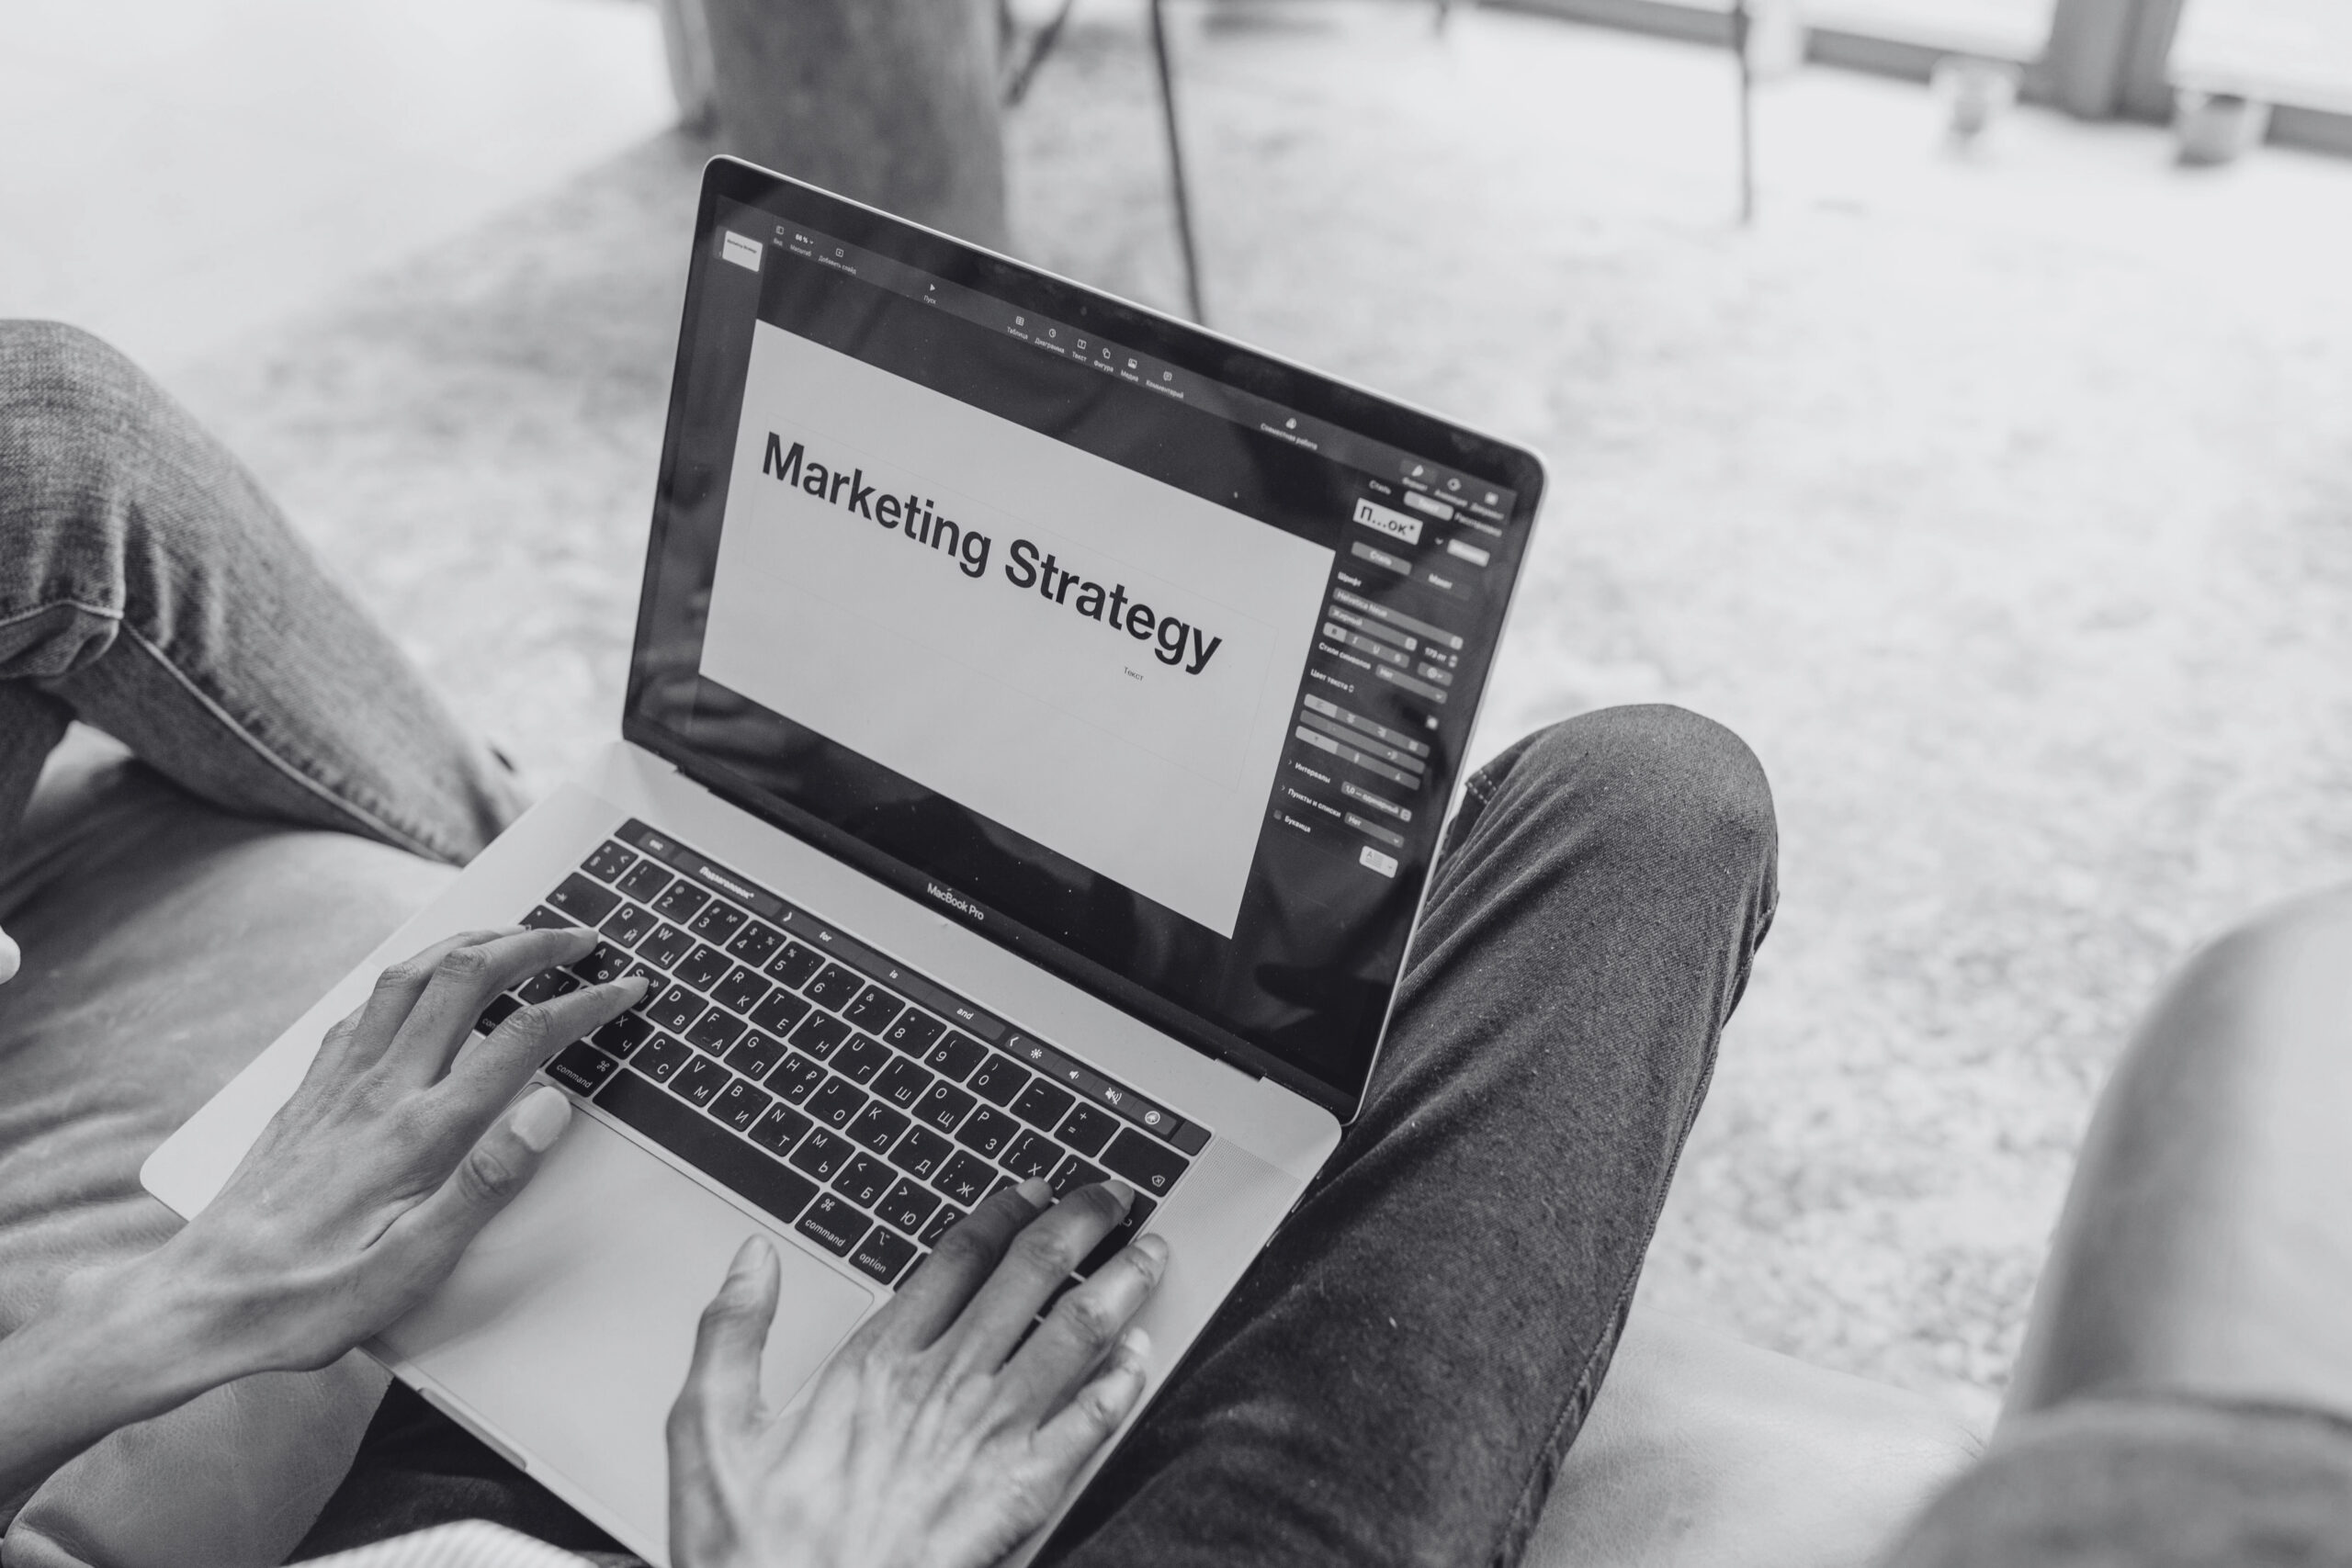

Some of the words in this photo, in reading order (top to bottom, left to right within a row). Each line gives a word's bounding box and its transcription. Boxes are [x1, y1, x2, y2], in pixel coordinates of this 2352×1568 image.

[923, 294, 936, 305] Пуск
[1007, 326, 1028, 340] Таблица
[1035, 337, 1065, 354] Диаграмма
[1072, 351, 1087, 363] Текст
[1093, 359, 1114, 373] Фигура
[763, 431, 991, 579] Marketing
[1005, 538, 1223, 676] Strategy
[1124, 666, 1145, 682] Текст
[1310, 668, 1327, 682] Цвет
[1295, 762, 1330, 784] Интервалы
[1288, 787, 1312, 806] Пункты
[1317, 803, 1341, 818] списки
[1284, 815, 1311, 834] Буквица
[628, 877, 636, 886] 1
[662, 897, 673, 907] 2
[927, 882, 968, 912] MacBook
[968, 904, 985, 920] Pro
[622, 908, 633, 919] Q
[699, 918, 709, 928] 3
[624, 929, 638, 941] Й
[658, 928, 673, 941] W
[820, 931, 832, 942] for
[737, 939, 747, 948] 4
[595, 948, 606, 958] A
[661, 952, 674, 964] Ц
[695, 950, 707, 961] E
[775, 961, 786, 970] 5
[598, 970, 608, 979] Ф
[733, 971, 744, 983] R
[889, 970, 899, 978] is
[814, 983, 825, 992] 6
[669, 990, 681, 1001] D
[774, 993, 785, 1004] T
[854, 1005, 865, 1014] 7
[957, 1009, 974, 1020] and
[616, 1016, 628, 1027] X
[707, 1013, 720, 1023] F
[813, 1016, 825, 1027] Y
[895, 1028, 906, 1038] 8
[654, 1039, 665, 1050] C
[748, 1036, 759, 1047] G
[853, 1040, 865, 1051] U
[936, 1052, 946, 1062] 9
[695, 1061, 706, 1073] V
[751, 1061, 764, 1073] П
[786, 1059, 800, 1071] H
[858, 1066, 870, 1075] Г
[556, 1064, 593, 1088] command
[979, 1075, 989, 1086] 0
[731, 1086, 742, 1097] B
[828, 1085, 839, 1094] J
[895, 1086, 911, 1100] Ш
[935, 1088, 946, 1099] O
[735, 1111, 750, 1123] И
[772, 1110, 785, 1122] N
[869, 1108, 882, 1120] K
[937, 1111, 954, 1128] Щ
[978, 1111, 989, 1121] P
[812, 1134, 828, 1148] M
[873, 1134, 888, 1146] Л
[911, 1132, 919, 1145] L
[1023, 1137, 1034, 1149] {
[1011, 1152, 1020, 1164] [
[857, 1163, 867, 1171] <
[915, 1159, 931, 1174] Д
[1067, 1163, 1077, 1174] }
[860, 1187, 873, 1200] Б
[899, 1187, 908, 1196] >
[956, 1181, 974, 1197] Ж
[900, 1211, 916, 1225] Ю
[944, 1213, 955, 1224] ?
[805, 1219, 845, 1247] command
[930, 1228, 943, 1238] /
[859, 1253, 886, 1273] option
